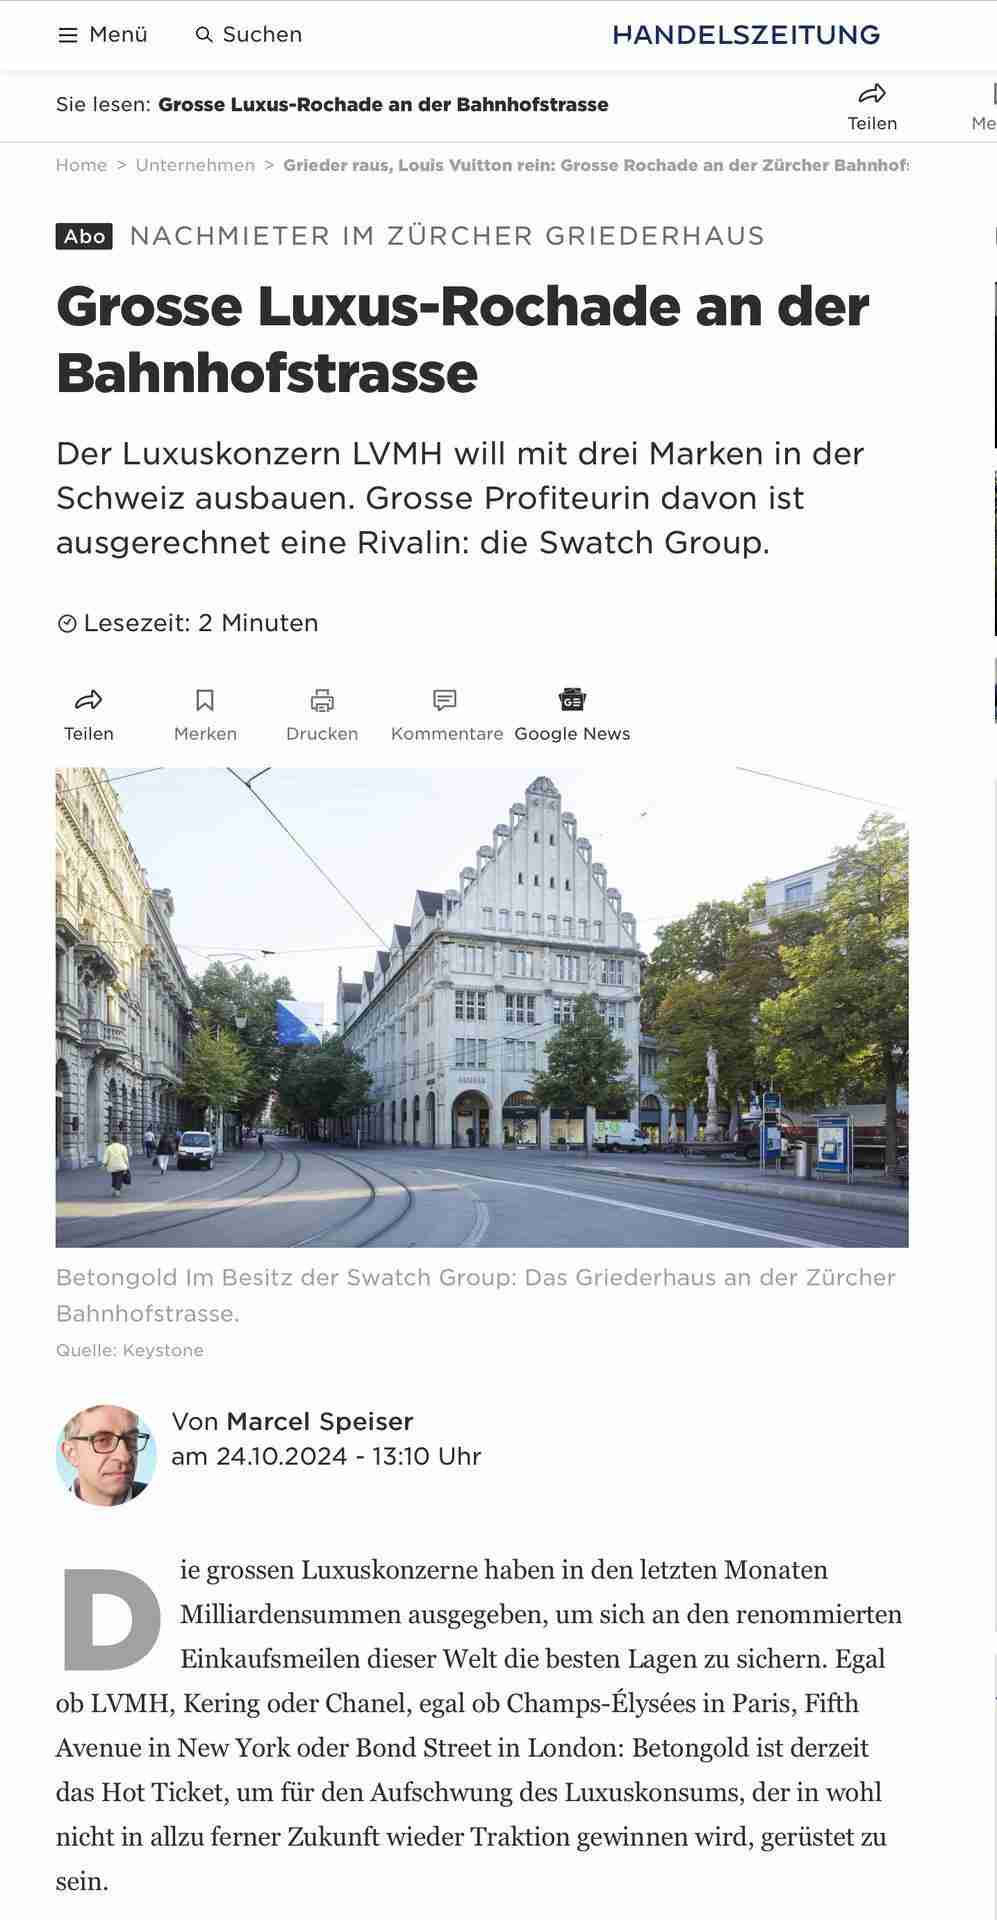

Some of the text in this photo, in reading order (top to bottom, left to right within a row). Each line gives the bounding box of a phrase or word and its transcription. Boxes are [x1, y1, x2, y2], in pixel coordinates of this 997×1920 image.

[90, 25, 148, 43] Menü
[223, 24, 302, 43] Suchen
[613, 24, 881, 46] HANDELSZEITUNG
[56, 95, 609, 113] Sie lesen: Grosse Luxus-Rochade an der Bahnhofstrasse
[847, 115, 897, 131] Teilen
[56, 158, 107, 173] Home
[135, 157, 256, 173] Unternehmen
[283, 158, 349, 172] Grieder
[352, 159, 394, 175] raus,
[398, 157, 445, 173] Louis
[448, 157, 513, 173] Vuitton
[517, 158, 556, 172] rein:
[560, 158, 619, 173] Grosse
[623, 157, 699, 172] Rochade
[703, 161, 724, 173] an
[728, 157, 759, 172] der
[761, 158, 831, 172] Zürcher
[63, 228, 106, 244] Abo
[131, 221, 764, 247] NACHMIETER IM ZÜRCHER GRIEDERHAUS
[57, 283, 870, 327] Grosse Luxus-Rochade an der
[58, 350, 479, 394] Bahnhofstrasse
[57, 440, 865, 466] Der Luxuskonzern LVMH will mit drei Marken in der
[56, 484, 805, 511] Schweiz ausbauen. Grosse Profiteurin davon ist
[56, 529, 769, 560] ausgerechnet eine Rivalin: die Swatch Group.
[85, 612, 318, 633] Lesezeit: 2 Minuten
[63, 726, 114, 741] Teilen
[174, 726, 237, 741] Merken
[287, 726, 358, 741] Drucken
[391, 727, 504, 741] Kommentare
[514, 726, 631, 744] Google News
[56, 1267, 897, 1290] Betongold Im Besitz der Swatch Group: Das Griederhaus an der Zürcher
[57, 1303, 239, 1323] Bahnhofstrasse.
[56, 1343, 204, 1360] Quelle: Keystone
[171, 1411, 414, 1435] Von Marcel Speiser
[171, 1450, 208, 1466] am
[216, 1446, 348, 1466] 24.10.2024
[372, 1446, 430, 1466] 13:10
[439, 1445, 482, 1466] Uhr
[180, 1557, 829, 1586] ie grossen Luxuskonzerne haben in den letzten Monaten
[179, 1602, 903, 1630] Milliardensummen ausgegeben, um sich an den renommierten
[180, 1647, 886, 1674] Einkaufsmeilen dieser Welt die besten Lagen zu sichern. Egal
[55, 1687, 860, 1719] ob LVMH, Kering oder Chanel, egal ob Champs-Élysées in Paris, Fifth
[54, 1735, 870, 1764] Avenue in New York oder Bond Street in London: Betongold ist derzeit
[55, 1780, 883, 1808] das Hot Ticket, um für den Aufschwung des Luxuskonsums, der in wohl
[55, 1824, 888, 1853] nicht in allzu ferner Zukunft wieder Traktion gewinnen wird, gerüstet zu
[55, 1869, 109, 1892] sein.
